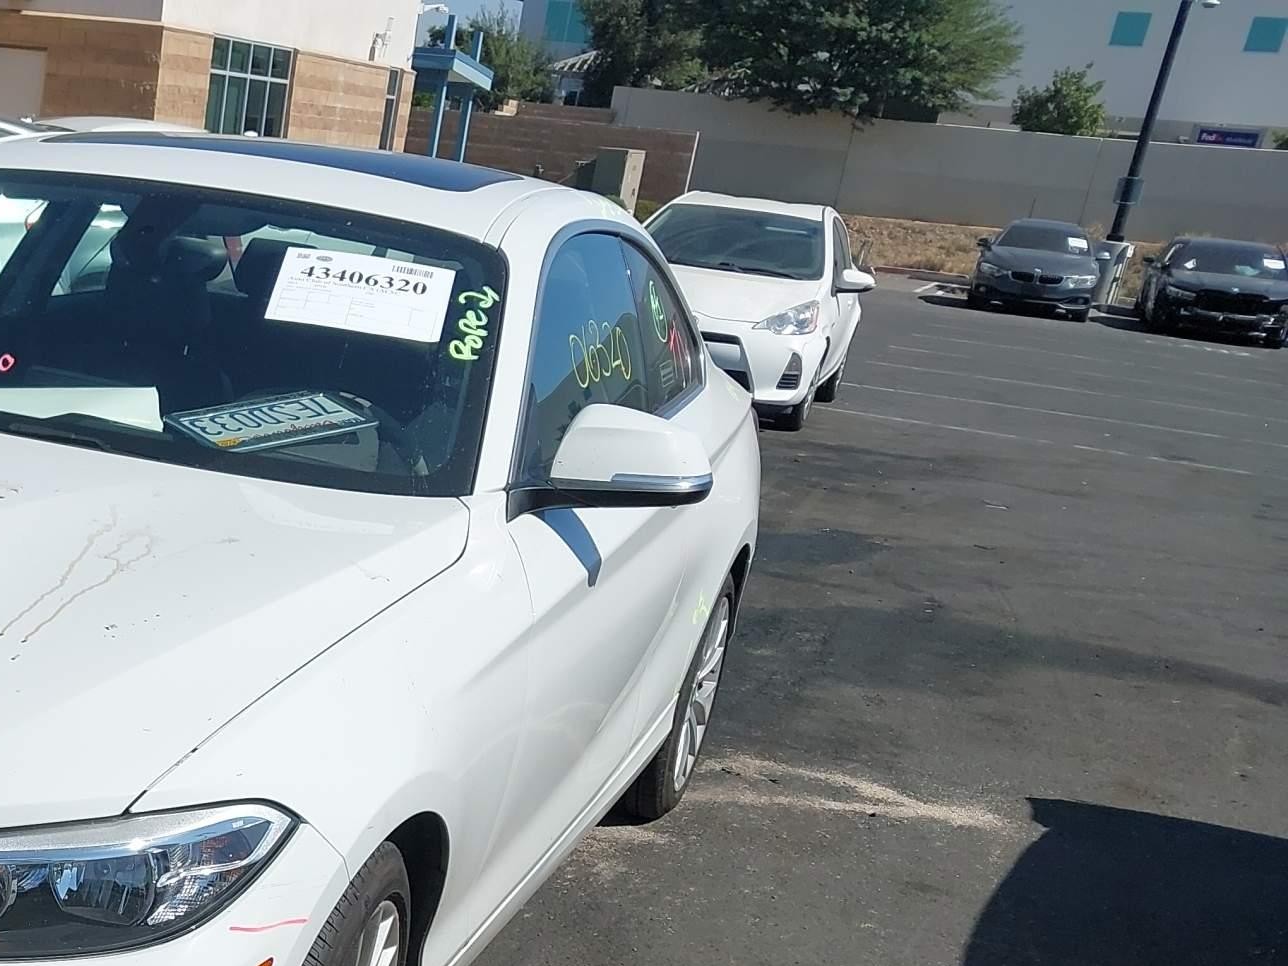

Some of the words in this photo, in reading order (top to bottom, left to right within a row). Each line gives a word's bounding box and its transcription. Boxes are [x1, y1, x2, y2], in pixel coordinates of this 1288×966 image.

[300, 265, 428, 296] 43406320
[569, 319, 632, 388] 06320
[189, 398, 344, 436] 7ESD033
